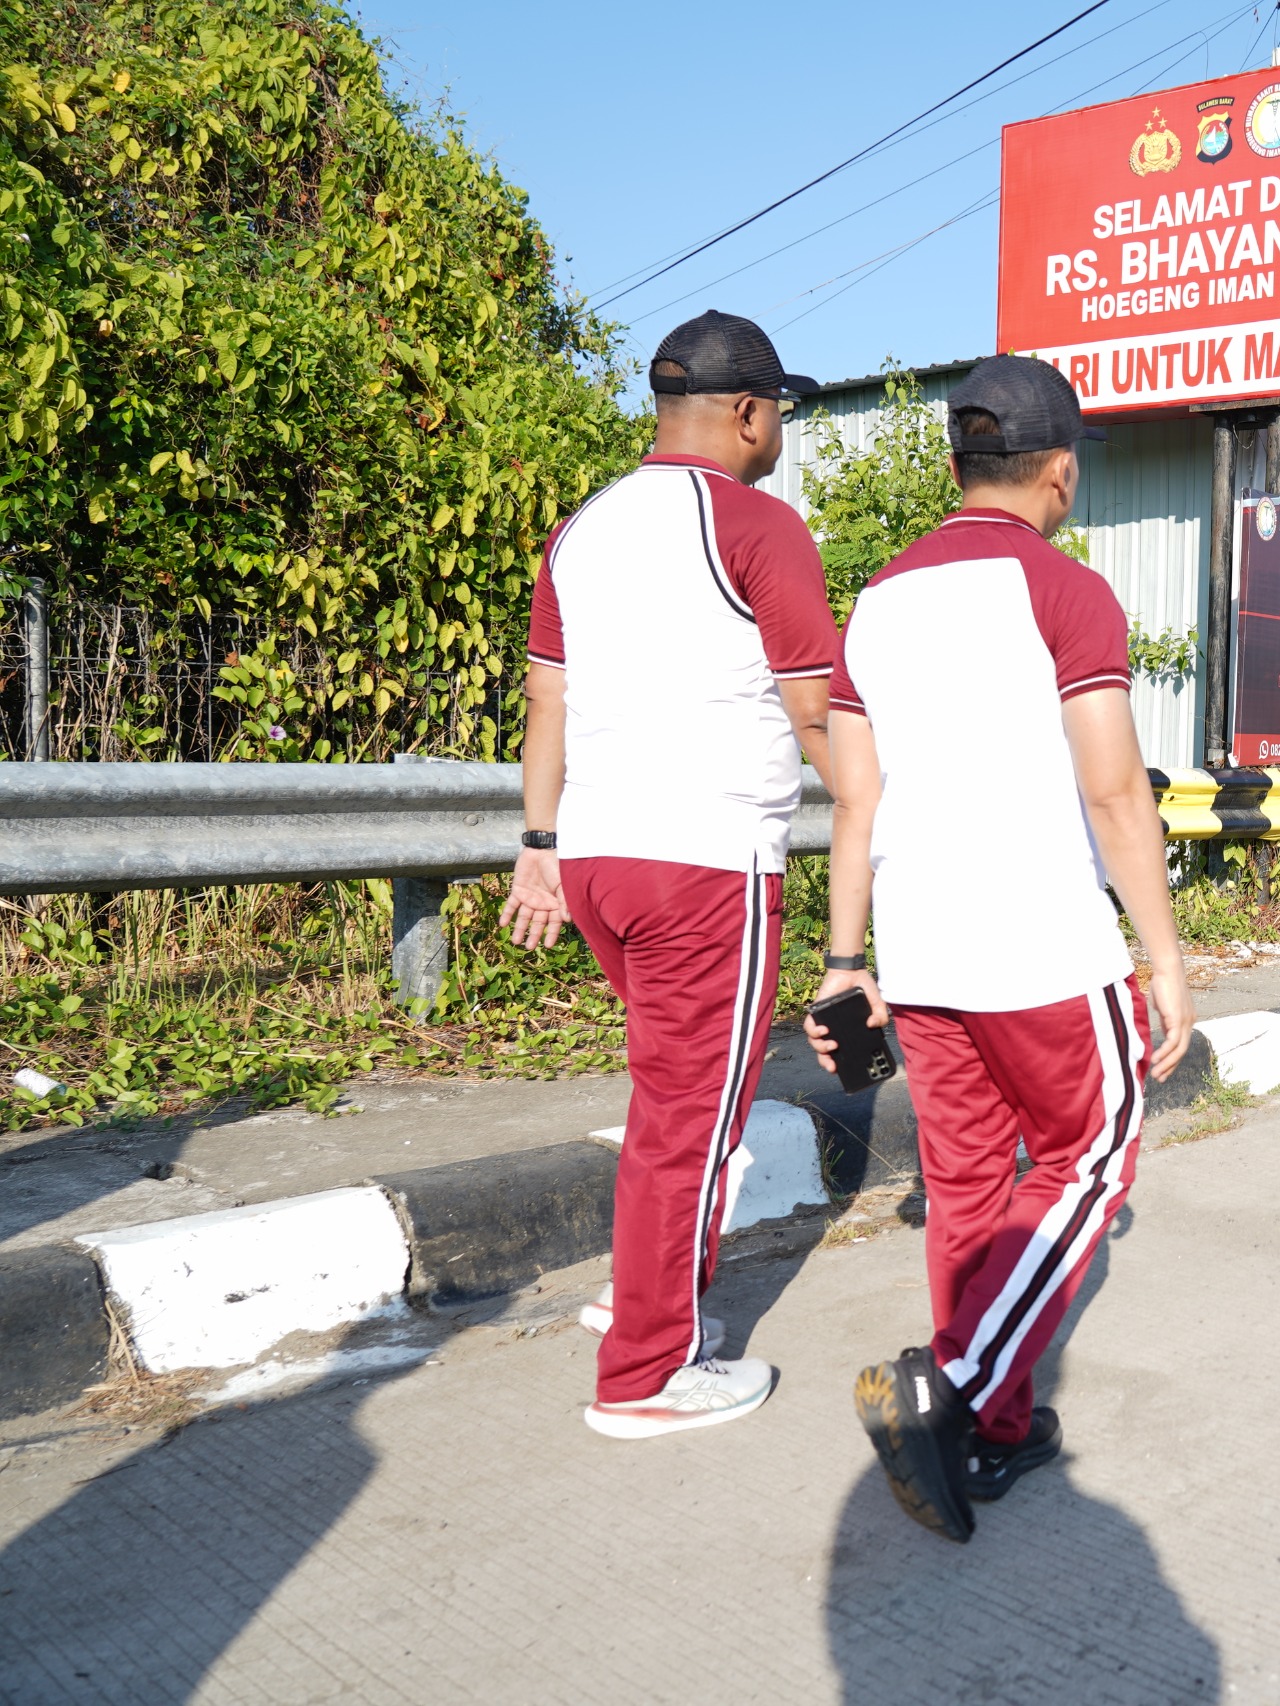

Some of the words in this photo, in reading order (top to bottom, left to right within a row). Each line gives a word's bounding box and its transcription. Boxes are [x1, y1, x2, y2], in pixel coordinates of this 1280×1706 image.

[1197, 99, 1219, 112] SULAWESI
[1093, 180, 1252, 239] SELAMAT
[1047, 250, 1108, 297] RS.
[1081, 281, 1200, 323] HOEGENG
[1208, 270, 1275, 306] IMAN
[1112, 340, 1232, 394] UNTUK
